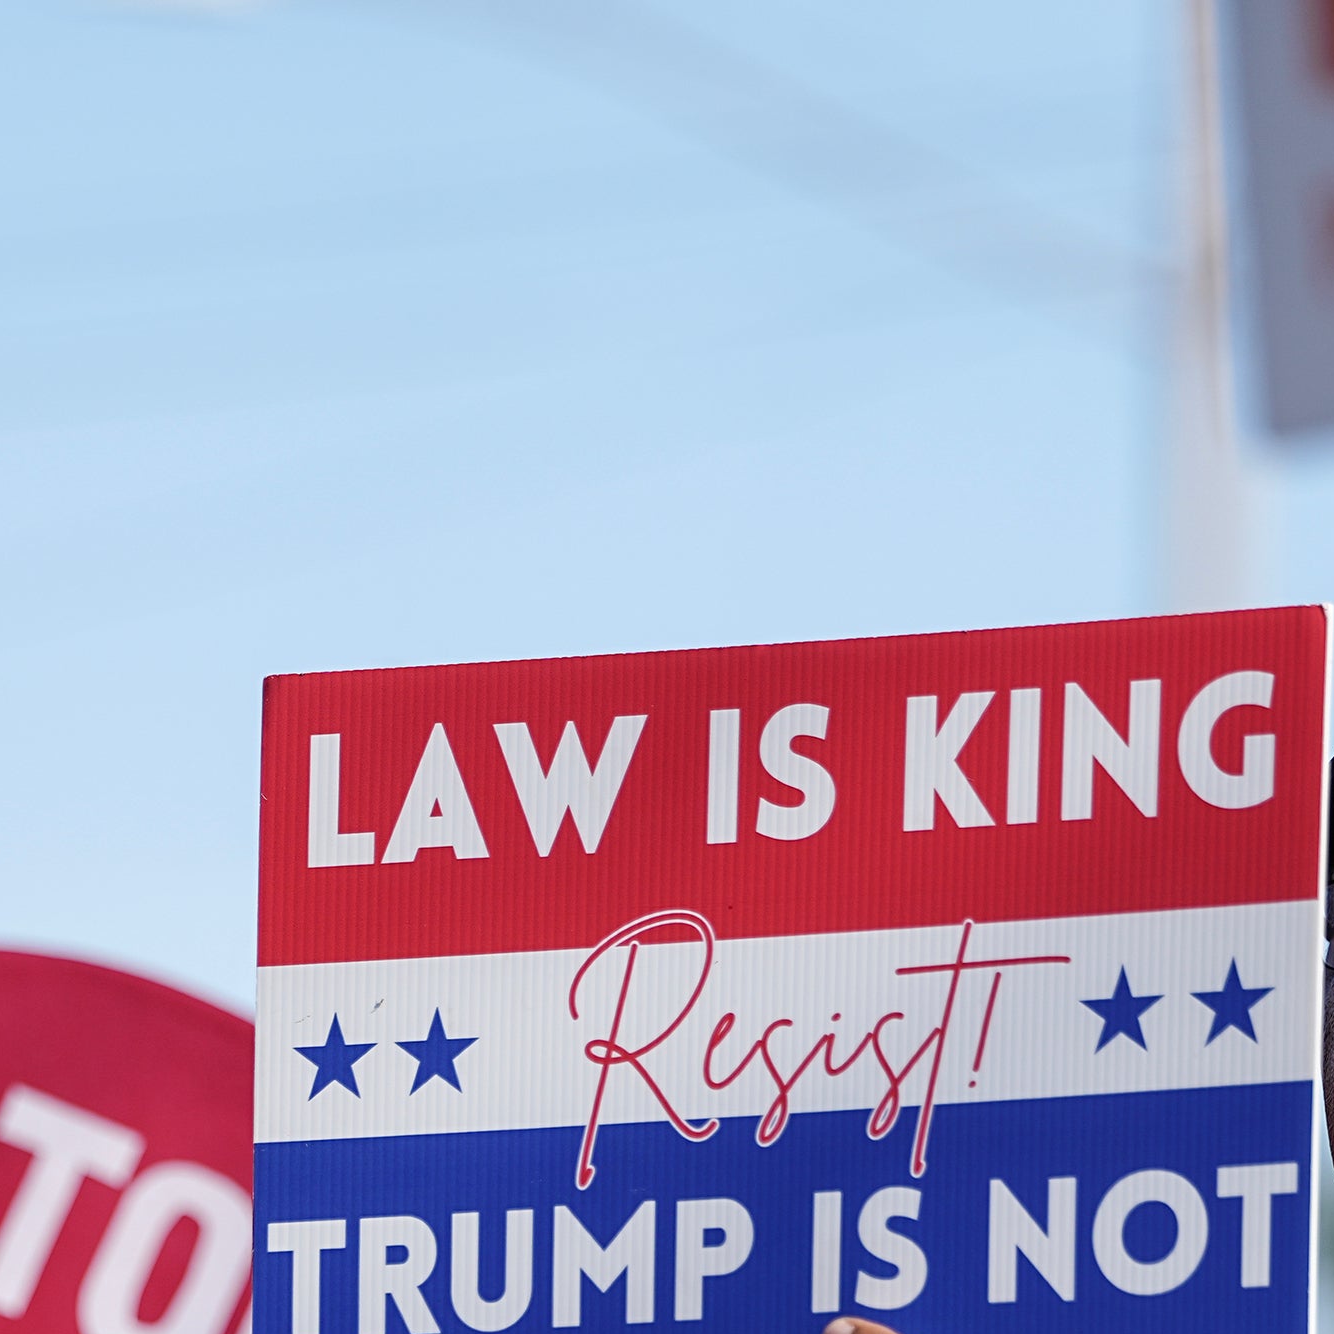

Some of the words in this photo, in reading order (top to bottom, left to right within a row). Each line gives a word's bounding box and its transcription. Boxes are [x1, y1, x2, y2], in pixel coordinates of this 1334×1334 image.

[307, 715, 648, 868] LAW
[706, 703, 836, 844] IS
[902, 669, 1276, 832] KING
[568, 909, 1071, 1189] Resist!
[811, 1185, 928, 1313] IS
[987, 1162, 1298, 1304] NOT
